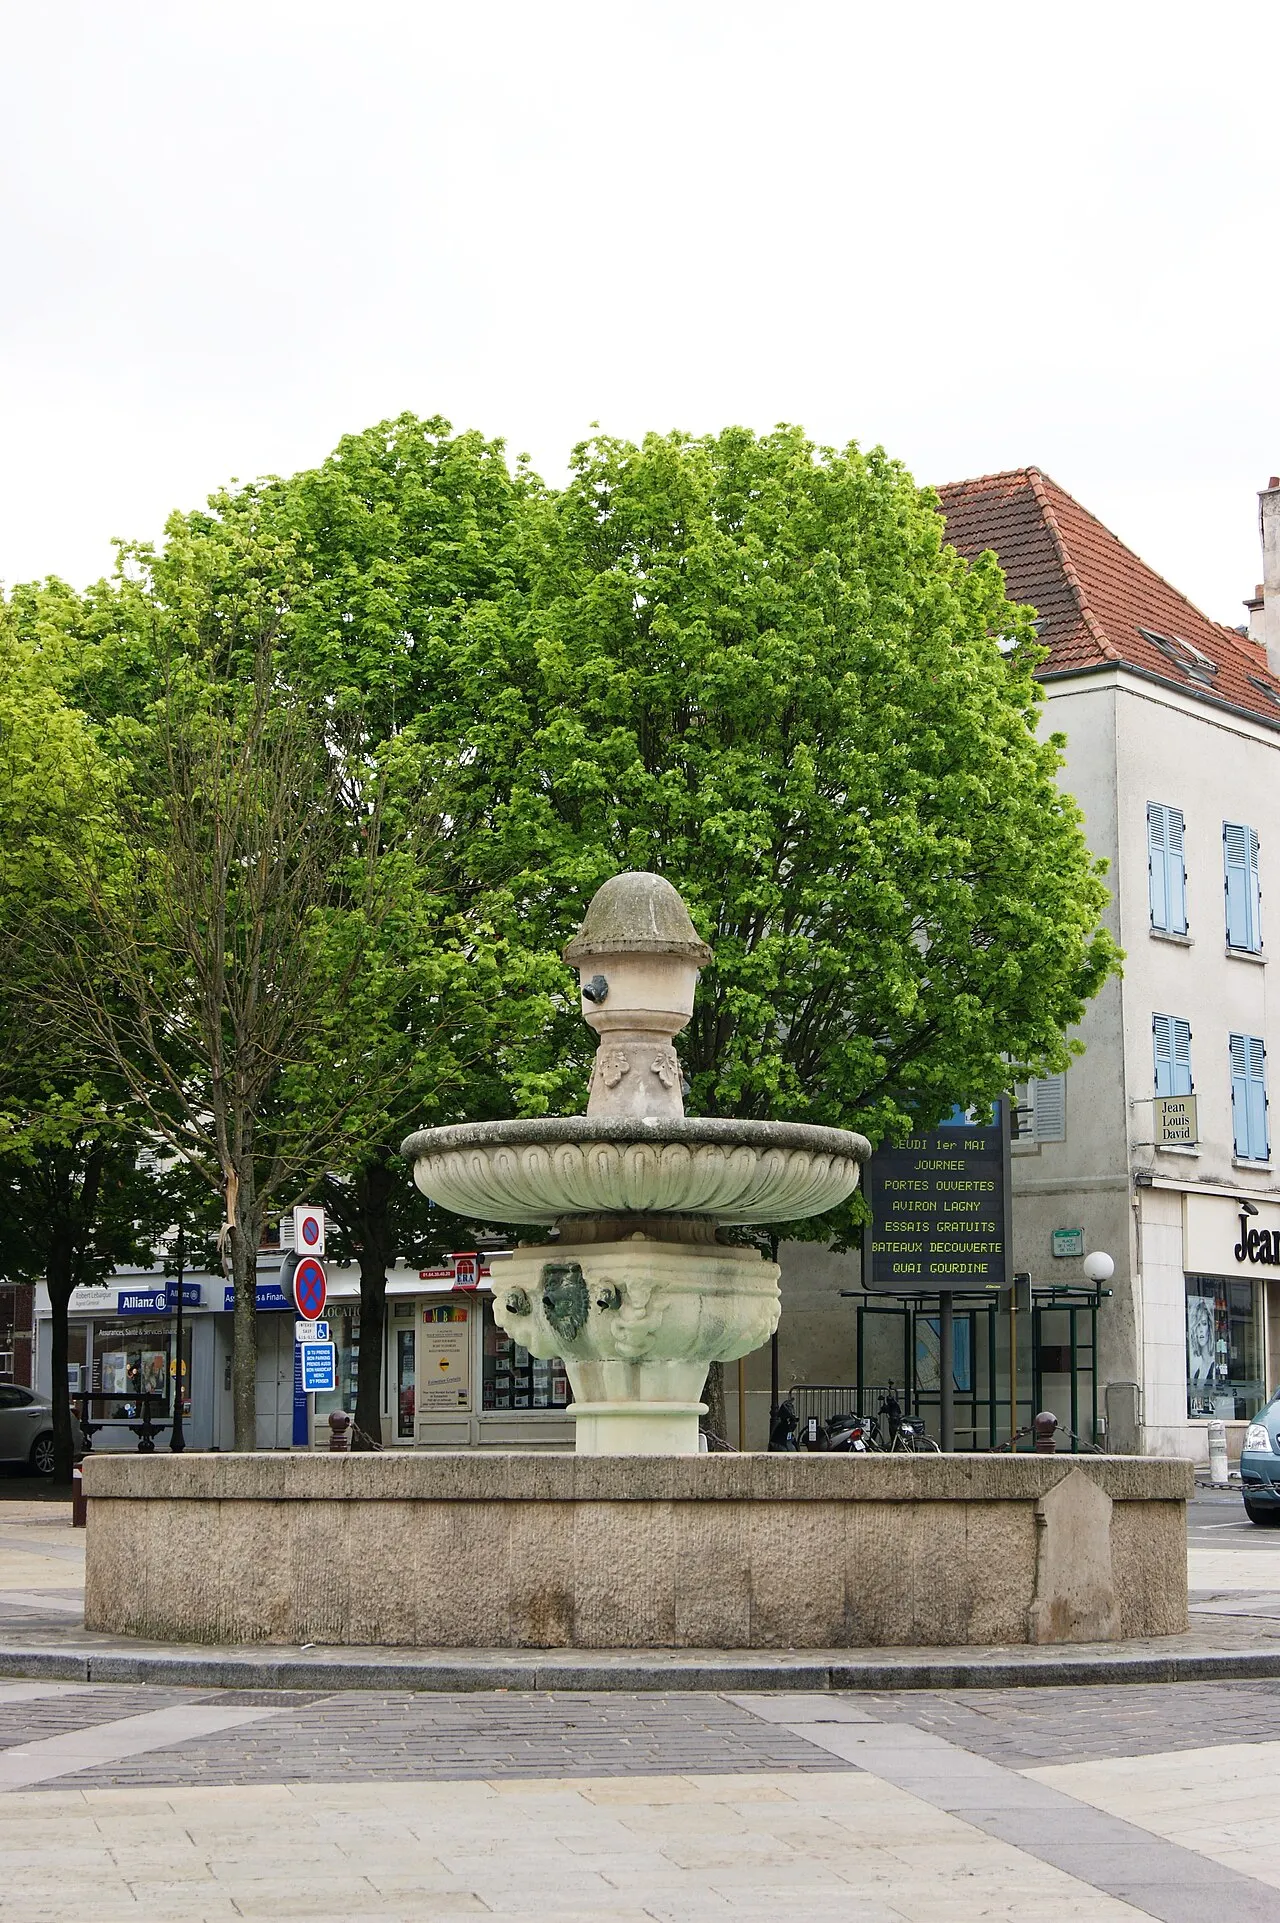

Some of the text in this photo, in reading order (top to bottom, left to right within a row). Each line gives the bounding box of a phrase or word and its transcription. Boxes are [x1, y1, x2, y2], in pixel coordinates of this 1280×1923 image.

[1162, 1101, 1185, 1113] Jean
[1162, 1114, 1190, 1126] Louis
[1163, 1127, 1190, 1139] David
[936, 1140, 957, 1150] 1er
[964, 1140, 986, 1150] MAI
[914, 1160, 965, 1171] JOURNEE
[884, 1180, 995, 1191] PORTES OUVERTES
[892, 1201, 981, 1212] AVIRON LAGNY
[885, 1221, 996, 1232] ESSAIS GRATUITS
[872, 1242, 1002, 1253] BATEAUX DECOUVERTE
[893, 1263, 989, 1273] QUAI GOURDINE
[456, 1274, 474, 1283] ERA
[170, 1289, 190, 1298] Allnz
[123, 1296, 154, 1309] Allianz
